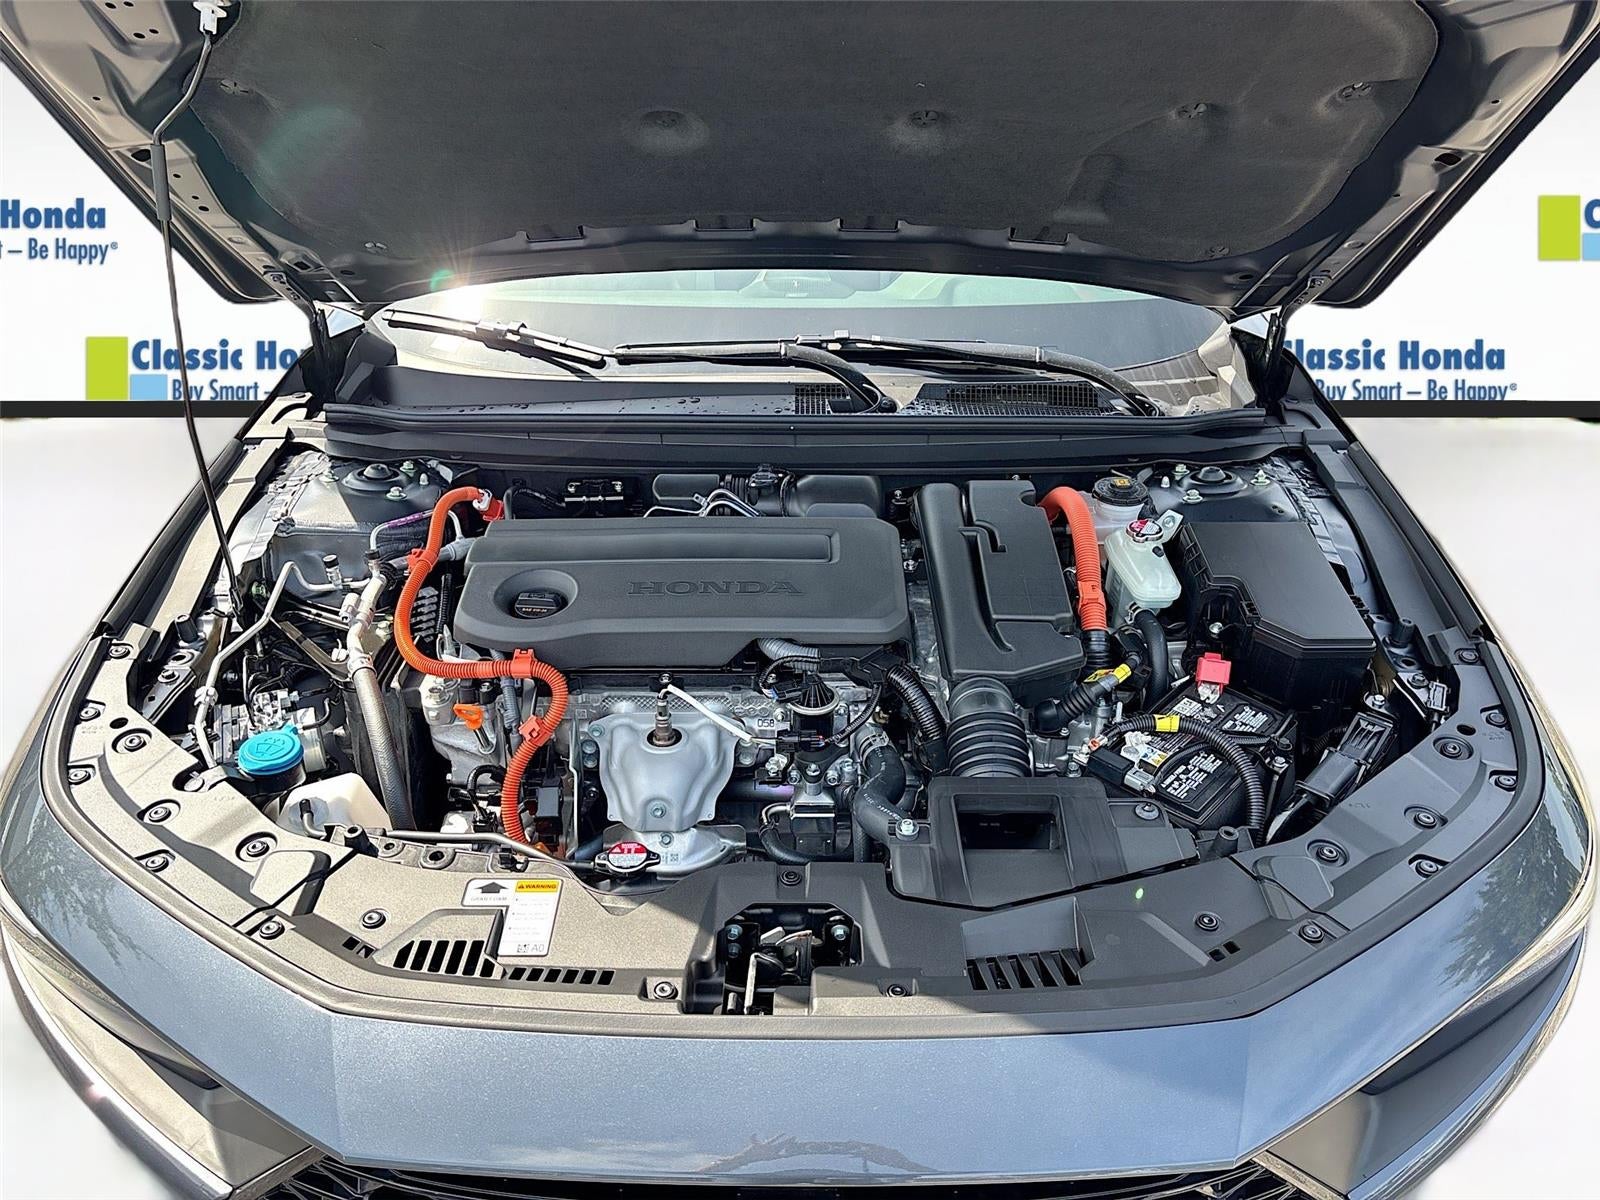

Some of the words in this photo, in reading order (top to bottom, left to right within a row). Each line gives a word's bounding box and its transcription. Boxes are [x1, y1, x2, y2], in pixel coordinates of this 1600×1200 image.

[0, 197, 106, 229] Honda
[28, 237, 49, 260] Be
[131, 338, 243, 370] Classic
[1284, 338, 1386, 370] lassic
[1399, 338, 1506, 370] Honda
[209, 378, 259, 400] Smart
[1352, 378, 1403, 400] Smart
[1428, 378, 1449, 400] Be
[627, 580, 805, 596] HONDA
